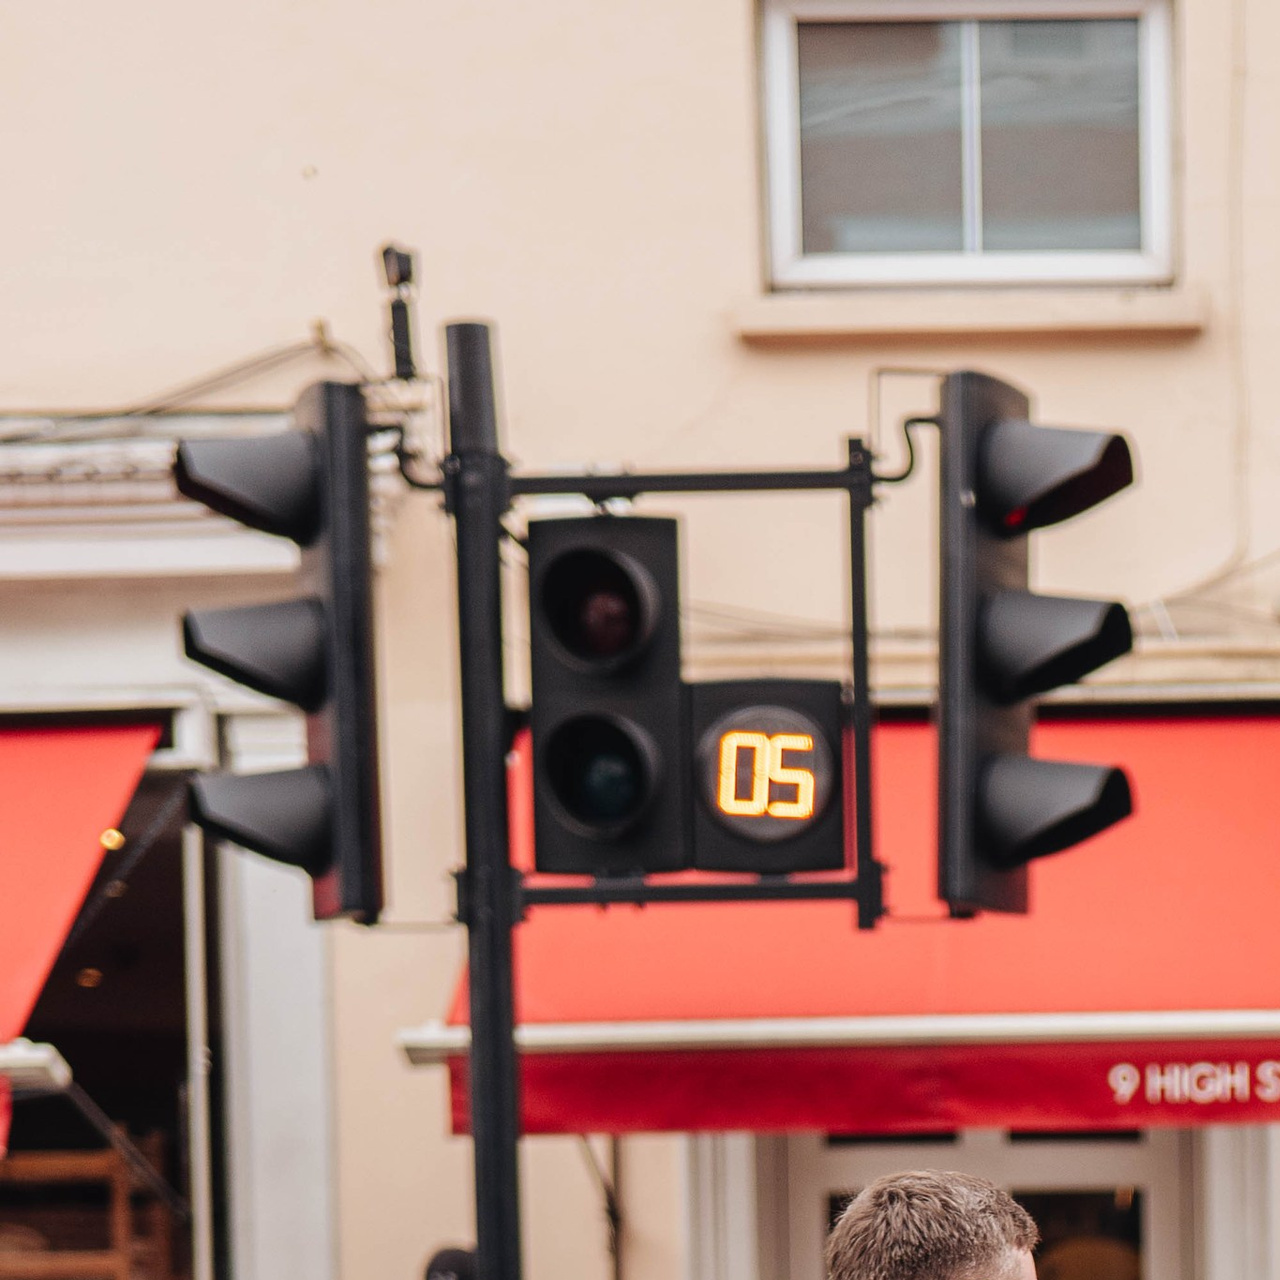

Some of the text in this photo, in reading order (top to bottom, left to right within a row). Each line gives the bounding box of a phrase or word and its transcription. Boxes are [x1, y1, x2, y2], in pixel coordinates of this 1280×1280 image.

[717, 729, 815, 819] 05
[1107, 1062, 1140, 1104] 9
[1145, 1061, 1250, 1104] HIGH
